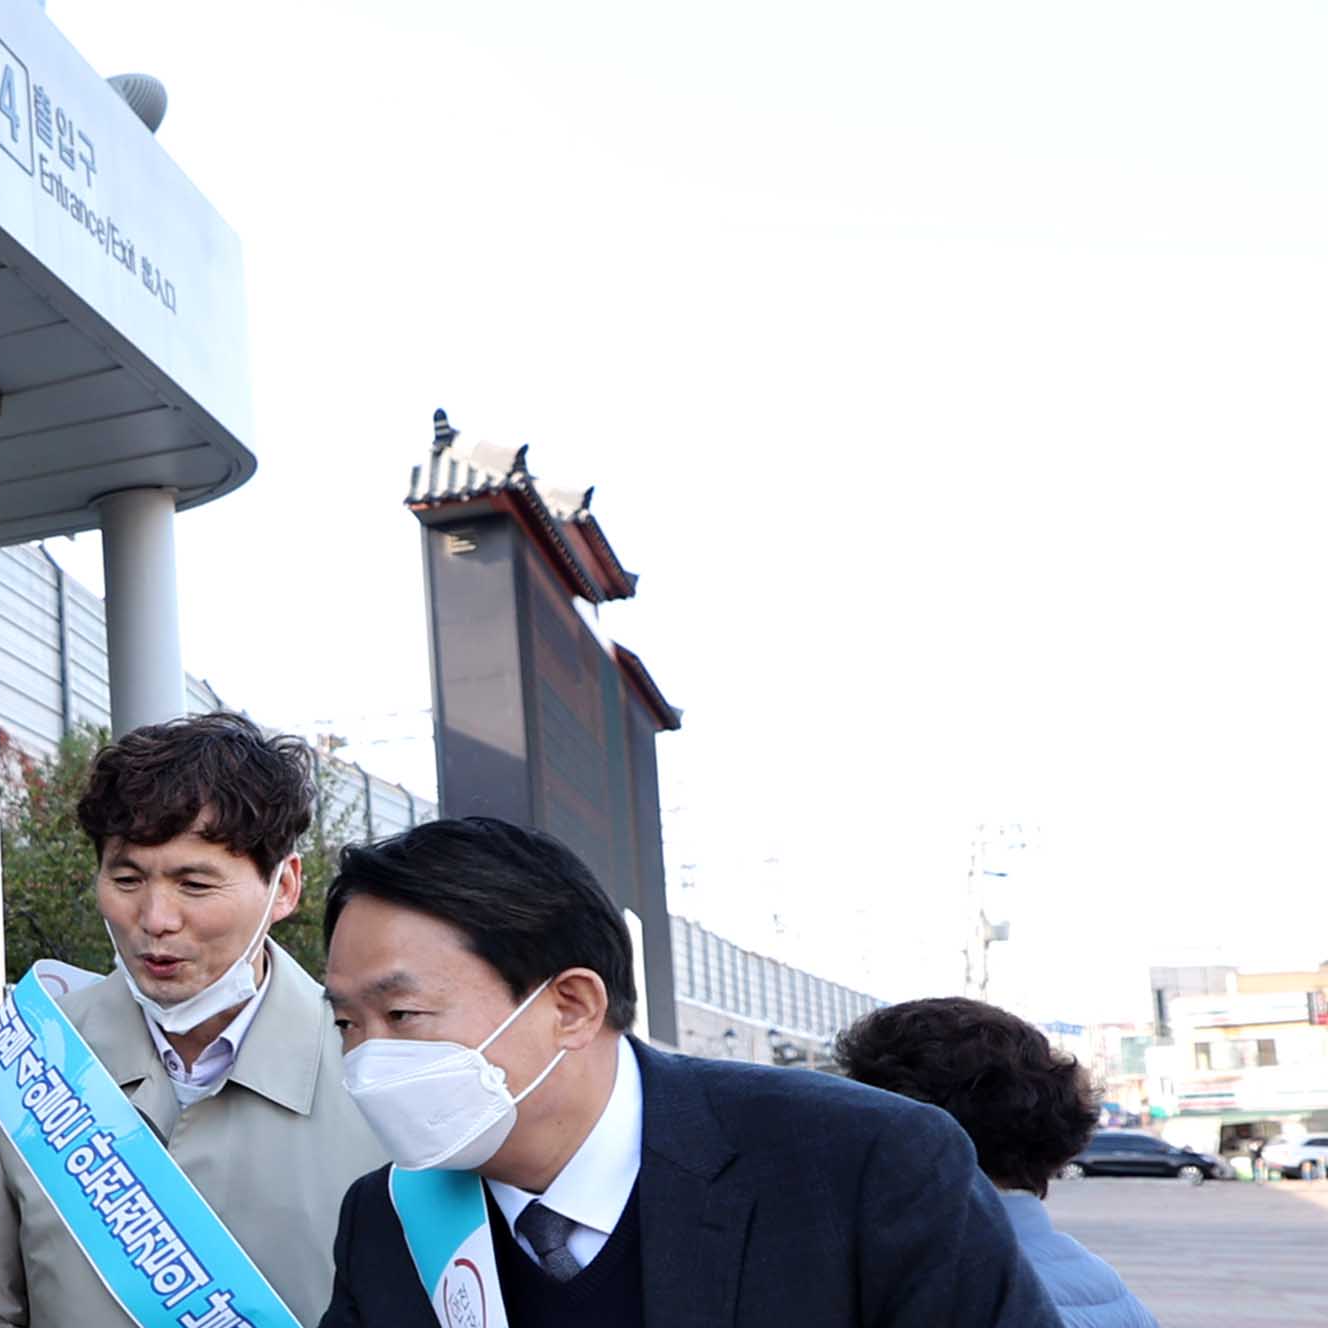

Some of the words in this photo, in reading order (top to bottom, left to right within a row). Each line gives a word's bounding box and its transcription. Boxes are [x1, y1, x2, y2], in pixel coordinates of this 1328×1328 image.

[0, 63, 20, 143] 4
[34, 84, 96, 188] 출입구
[40, 154, 136, 275] Entrance/Exit
[65, 1131, 213, 1308] 안전점검의
